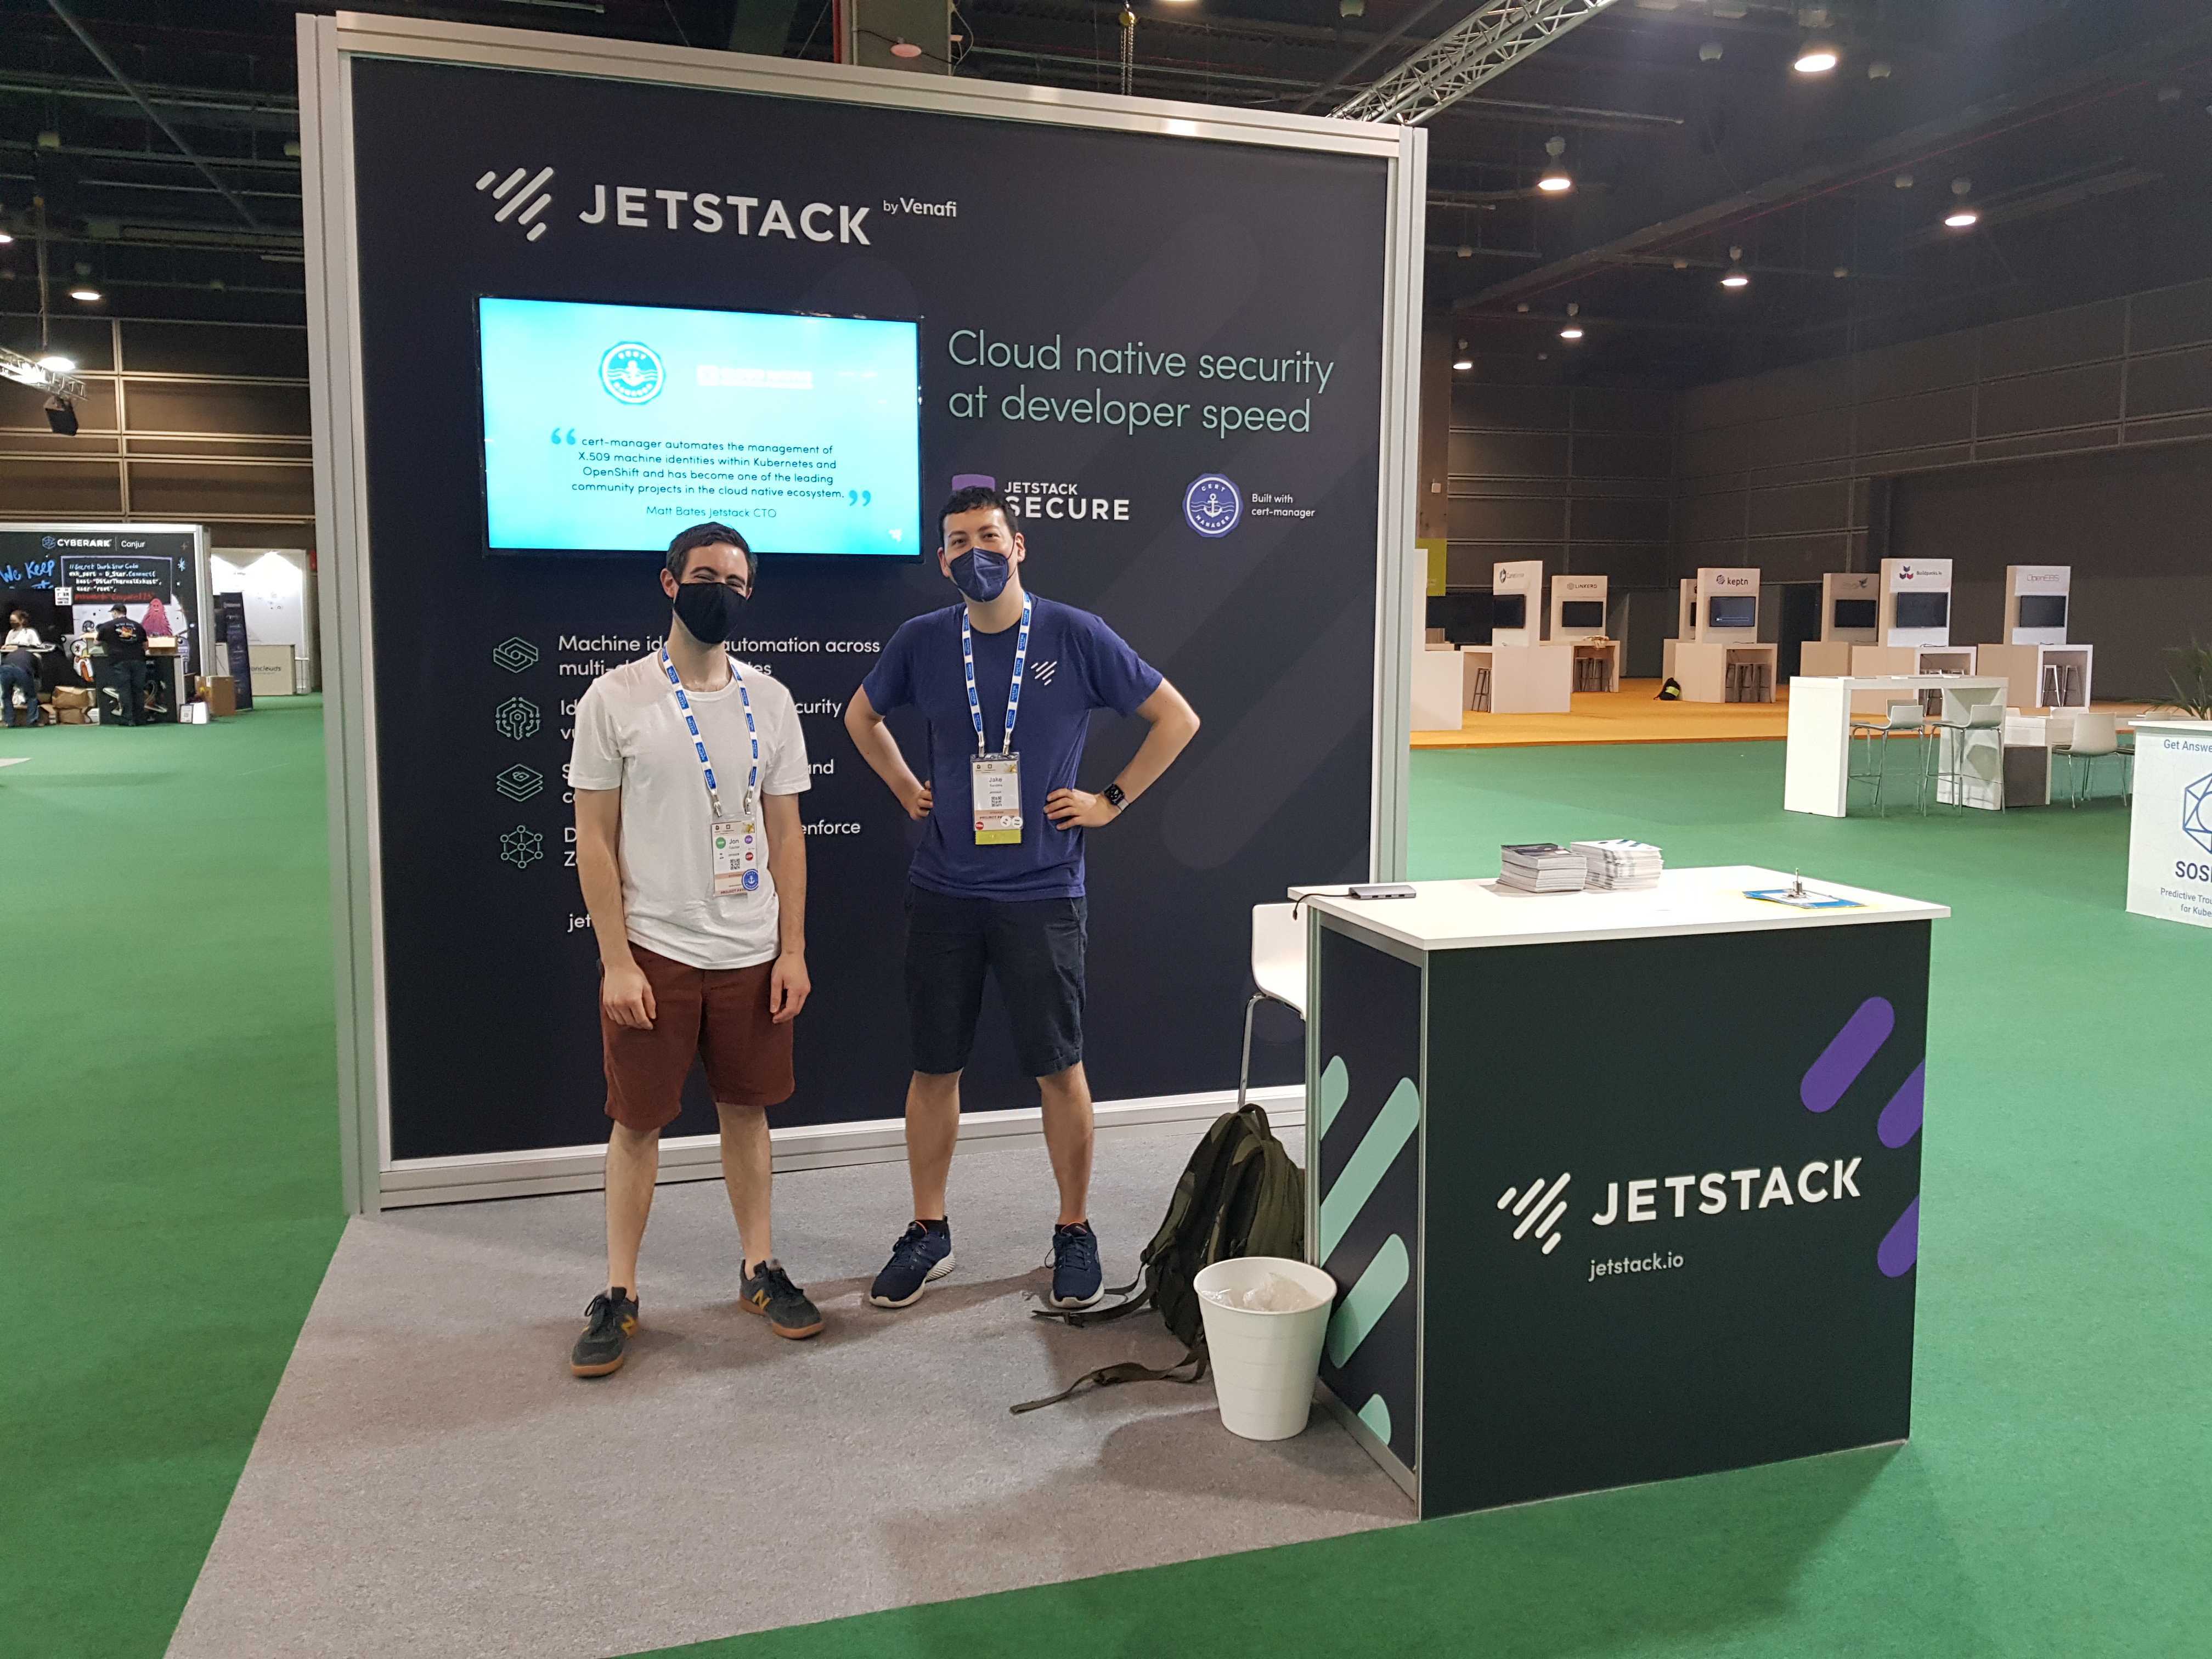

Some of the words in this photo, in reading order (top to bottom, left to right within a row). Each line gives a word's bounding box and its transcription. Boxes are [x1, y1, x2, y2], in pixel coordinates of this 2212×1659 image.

[579, 184, 871, 246] JETSTACK
[883, 199, 899, 215] by
[900, 197, 958, 218] Venafi
[948, 329, 1061, 371] Cloud
[1076, 341, 1187, 377] native
[1199, 350, 1334, 394] security
[949, 386, 988, 418] at
[1001, 385, 1190, 435] developer
[1202, 399, 1310, 439] speed
[582, 438, 662, 450] cert-manager
[665, 441, 724, 450] automates
[727, 442, 744, 451] the
[748, 444, 819, 455] management
[822, 445, 833, 454] of
[578, 452, 610, 461] X.509
[614, 454, 662, 463] machine
[665, 455, 714, 465] identities
[718, 456, 750, 466] within
[754, 458, 813, 468] Kubernetes
[816, 460, 836, 469] and
[583, 466, 639, 478] OpenShift
[643, 469, 664, 478] and
[668, 470, 686, 478] has
[691, 470, 734, 481] become
[761, 472, 771, 481] of
[775, 473, 791, 482] the
[794, 473, 833, 485] leading
[572, 483, 634, 494] community
[638, 484, 681, 495] projects
[698, 486, 715, 494] the
[719, 487, 747, 495] cloud
[751, 487, 783, 496] native
[787, 489, 845, 499] ecosystem.
[1005, 482, 1077, 495] JETSTACK
[1201, 483, 1226, 492] CERT
[1252, 494, 1271, 503] Built
[1274, 494, 1293, 504] with
[646, 506, 672, 515] Matt
[676, 506, 706, 516] Bates
[753, 509, 776, 518] CTO
[1005, 496, 1130, 521] SECURE
[1251, 507, 1315, 518] cert-manager
[1196, 515, 1230, 528] MANAGER
[57, 539, 110, 547] CYBERARK
[121, 540, 145, 549] Conjur
[1728, 578, 1748, 586] keptn
[558, 635, 640, 651] Machine
[724, 637, 820, 652] automation
[825, 641, 880, 653] across
[559, 659, 629, 675] multi-
[795, 699, 842, 717] curity
[2164, 739, 2180, 749] Get
[2160, 887, 2196, 901] Predictive
[2181, 904, 2191, 913] for
[2193, 906, 2212, 917] Kube
[1592, 1156, 1863, 1226] JETSTACK
[1588, 1252, 1684, 1282] jetstack.io
